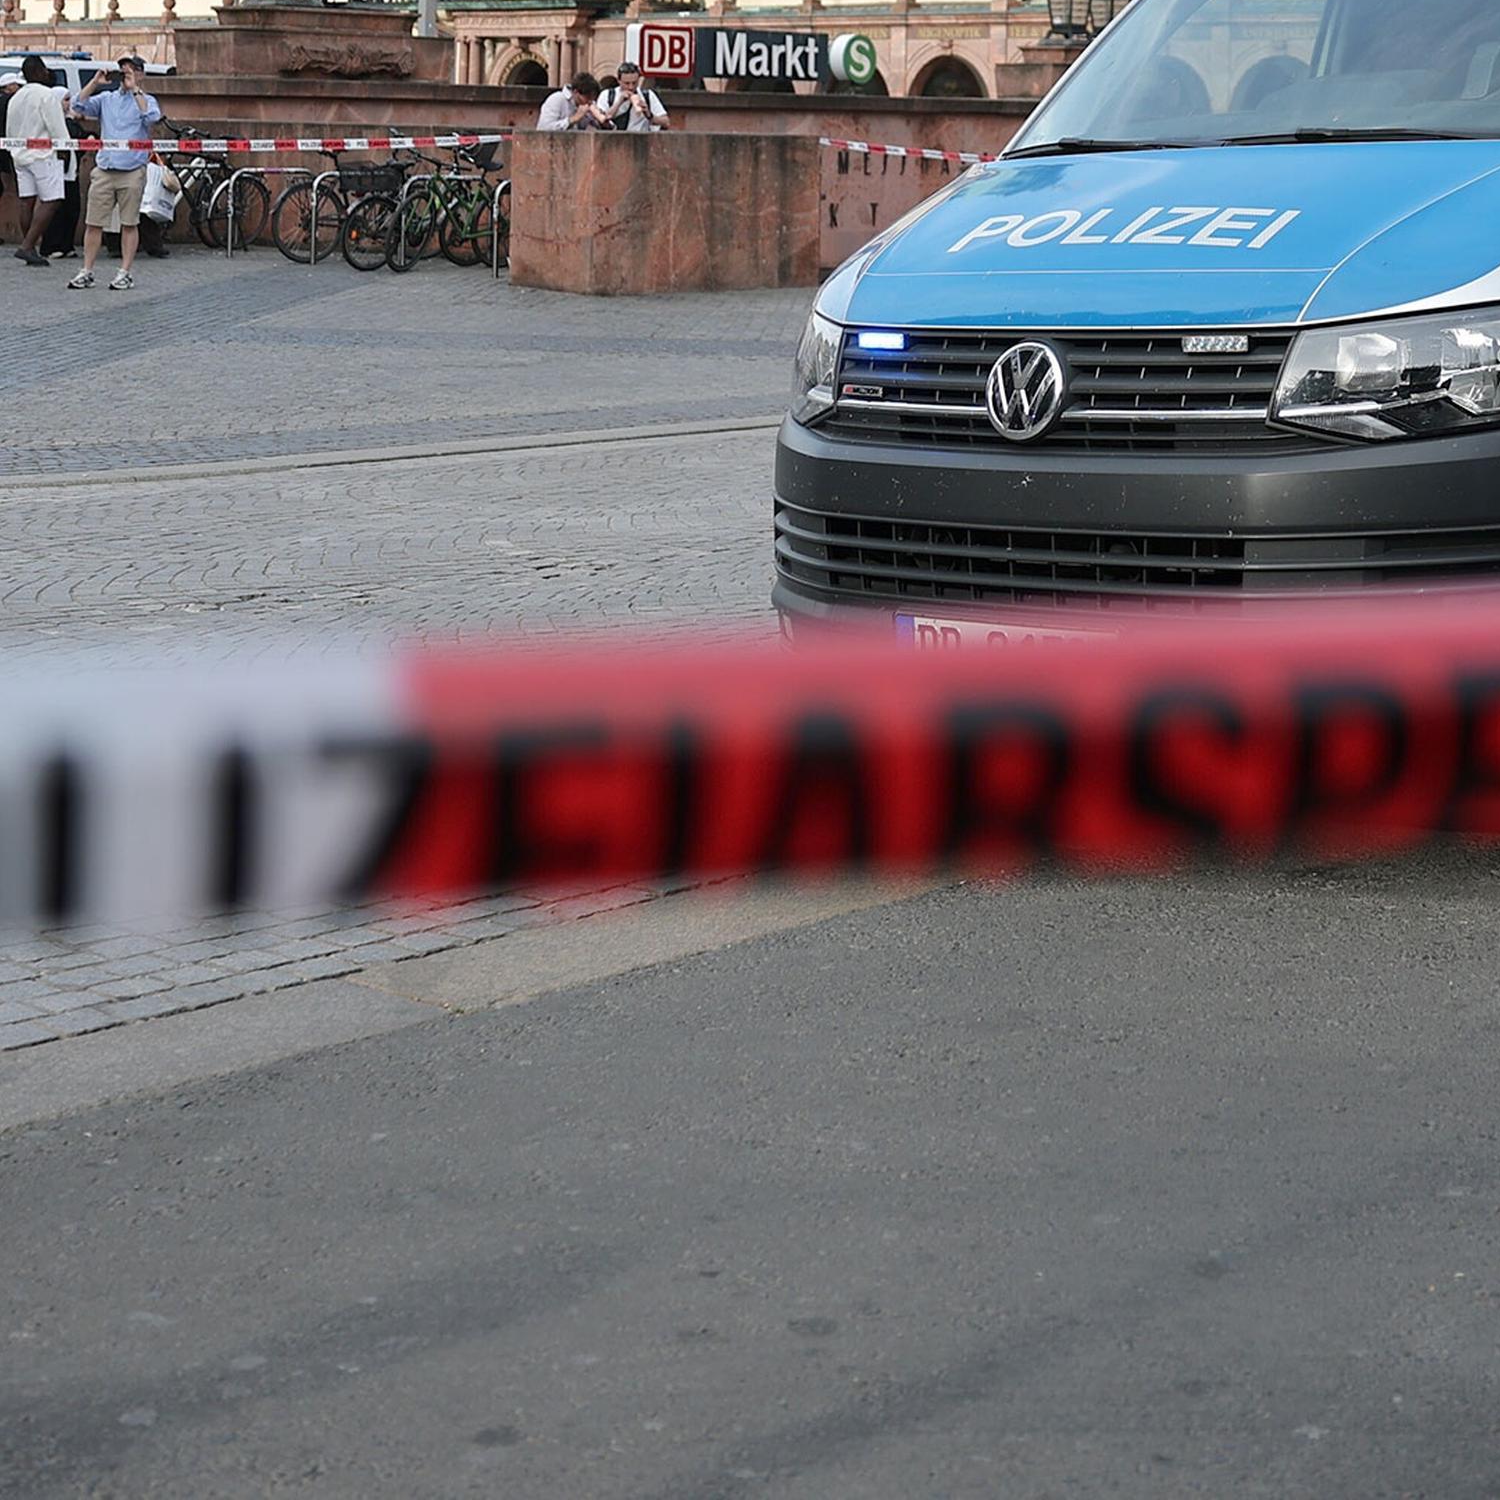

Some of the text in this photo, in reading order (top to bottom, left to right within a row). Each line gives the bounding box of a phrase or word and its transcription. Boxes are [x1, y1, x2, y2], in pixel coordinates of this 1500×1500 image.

[647, 30, 871, 79] DB Markt S
[946, 206, 1301, 252] POLIZEI
